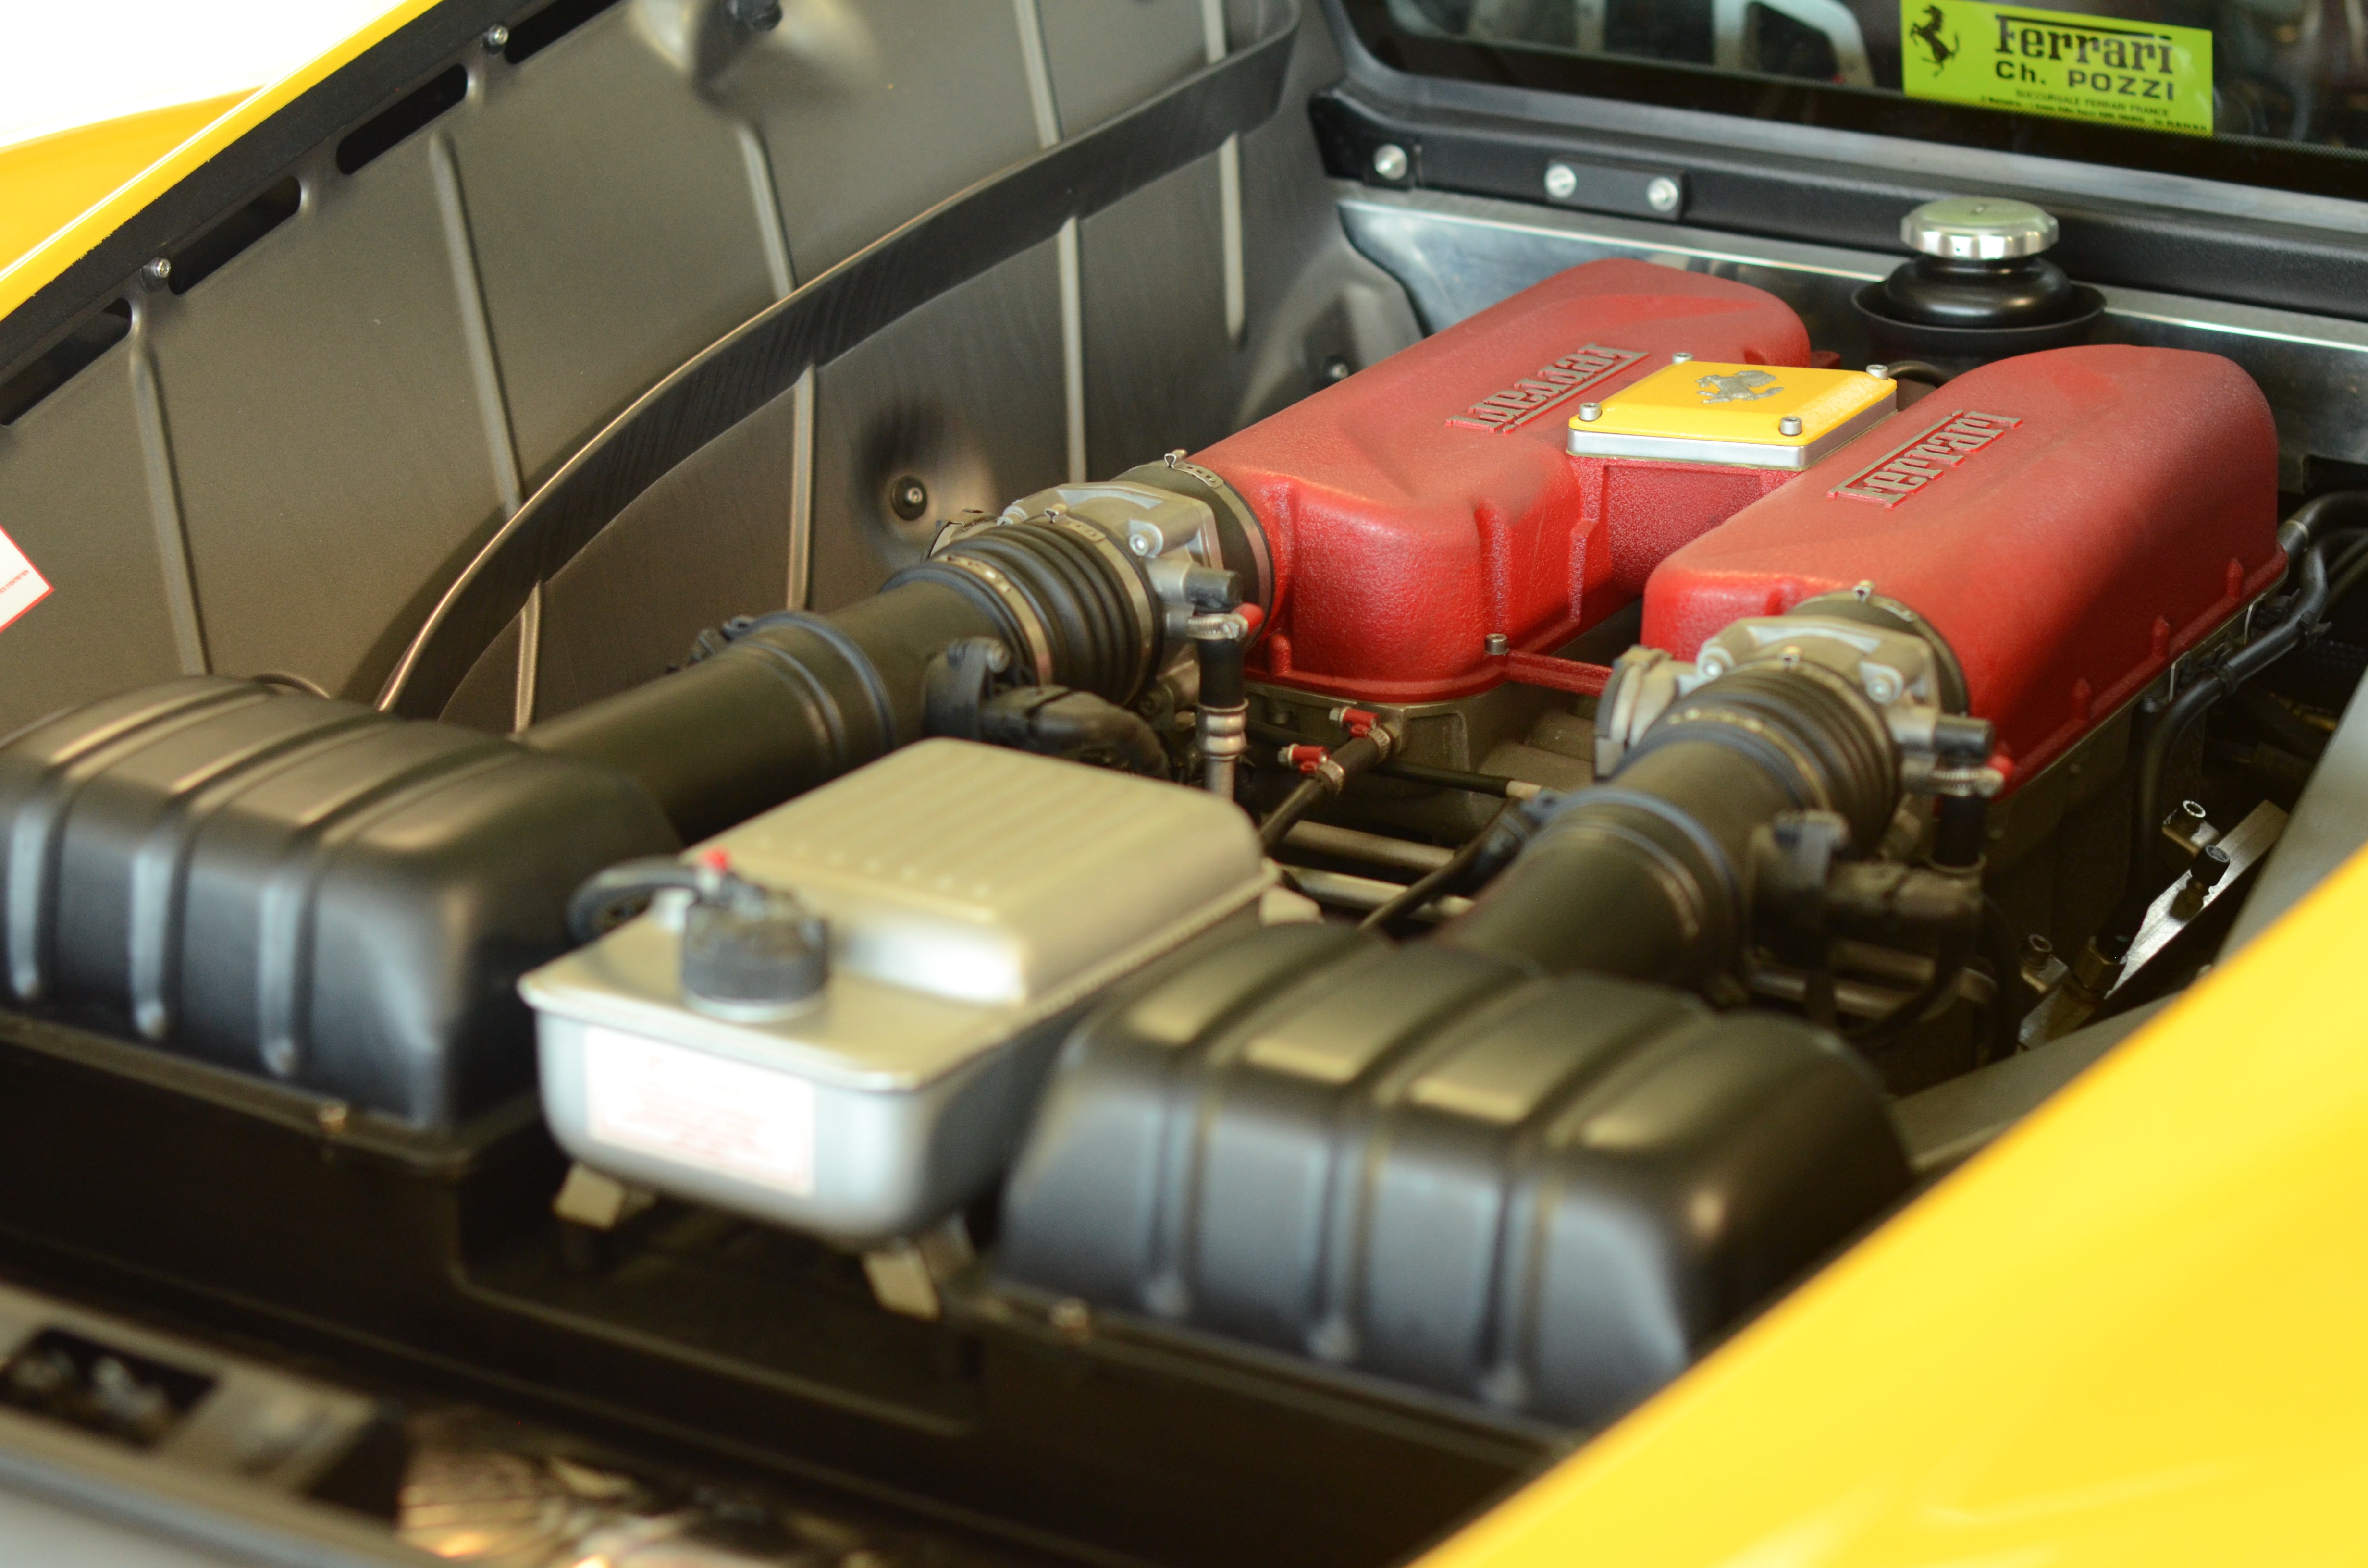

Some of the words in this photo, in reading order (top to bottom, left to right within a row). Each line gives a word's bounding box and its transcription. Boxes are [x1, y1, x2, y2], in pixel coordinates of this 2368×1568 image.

[1995, 14, 2173, 74] Ferrari
[1996, 61, 2046, 84] Ch.
[2068, 69, 2173, 101] POZZI
[1445, 343, 1650, 435] Ferrari
[1827, 409, 2023, 508] Ferrari
